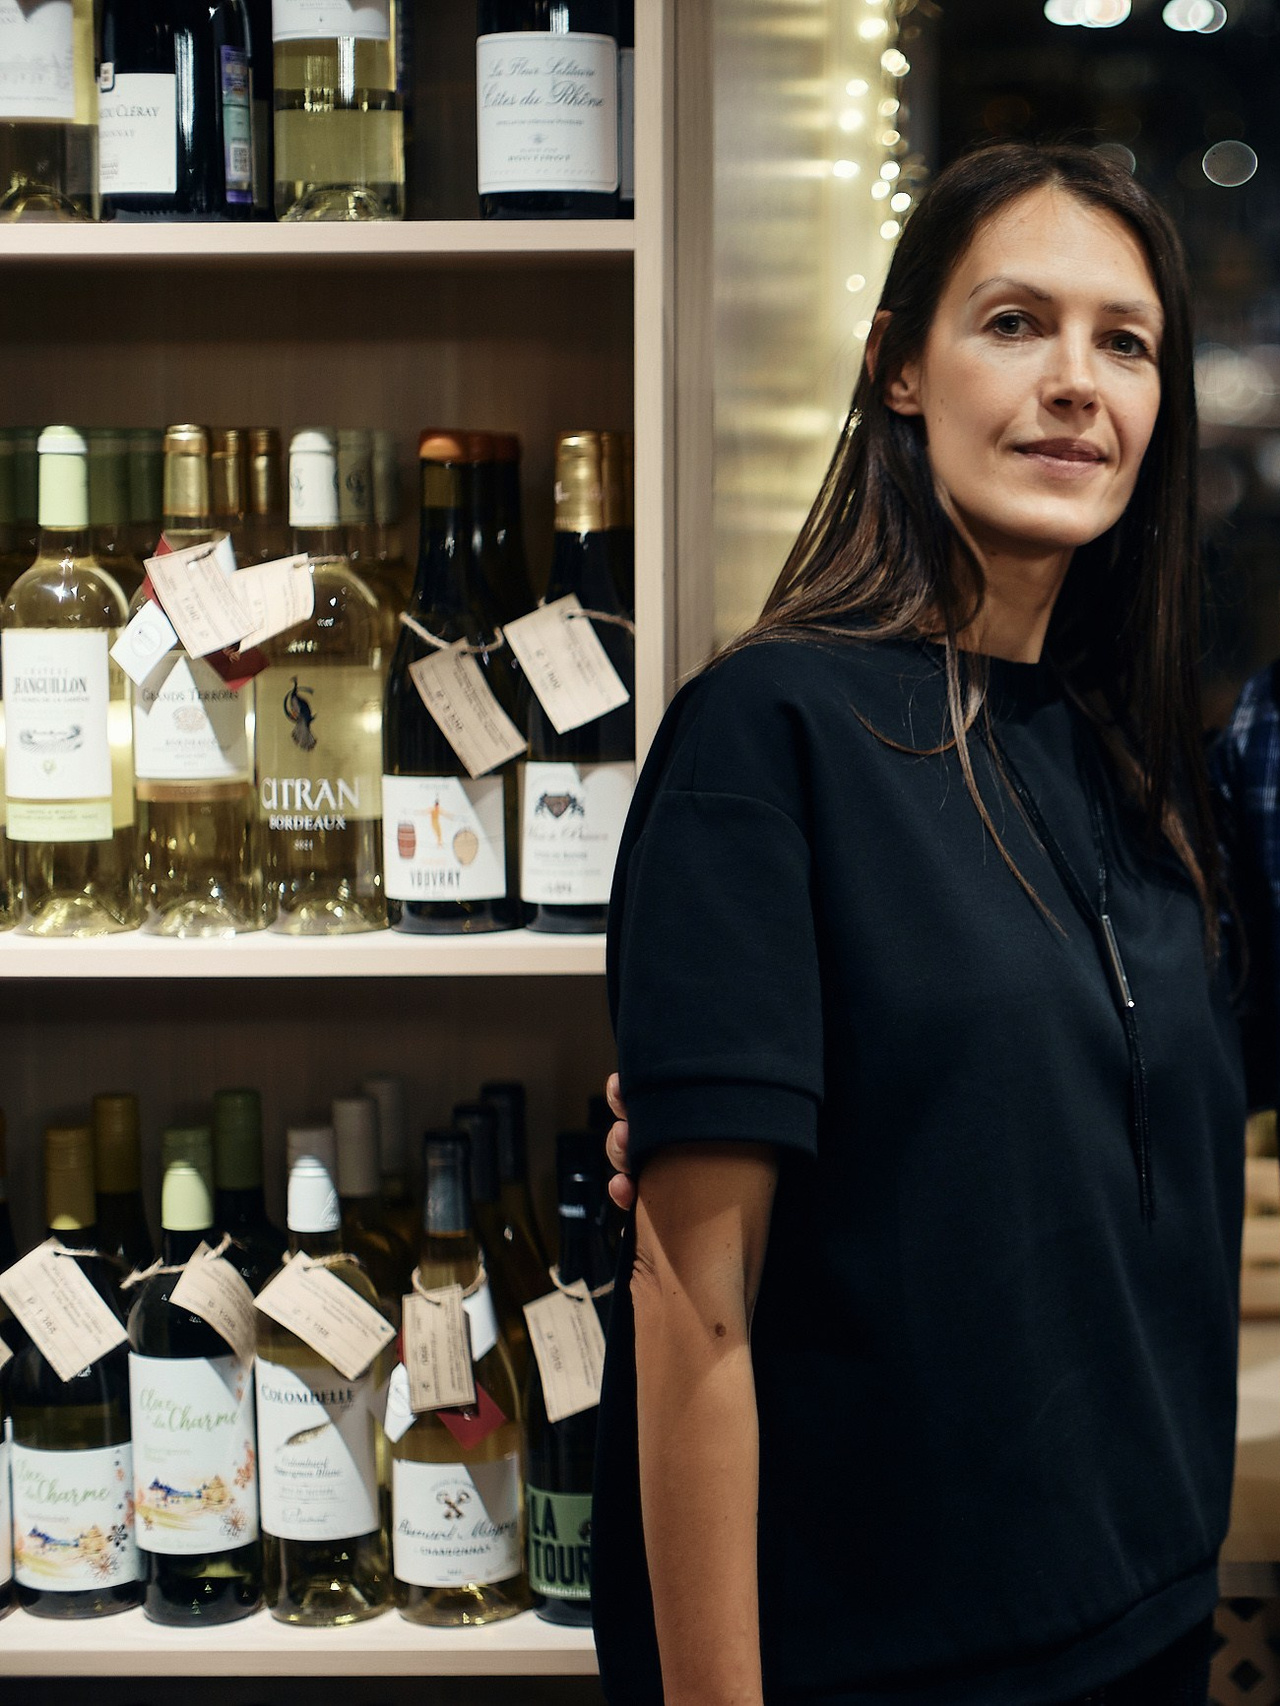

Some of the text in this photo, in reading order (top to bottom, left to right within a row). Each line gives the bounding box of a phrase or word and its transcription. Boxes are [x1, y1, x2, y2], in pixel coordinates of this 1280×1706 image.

[518, 88, 541, 106] du
[261, 777, 361, 811] CITRAN
[269, 814, 347, 831] BORDEAUX
[410, 868, 461, 888] VOUVRAY
[261, 1384, 355, 1406] COLOMBELLE
[168, 1404, 239, 1433] Charme
[37, 1478, 110, 1507] Charme
[531, 1494, 558, 1541] LA
